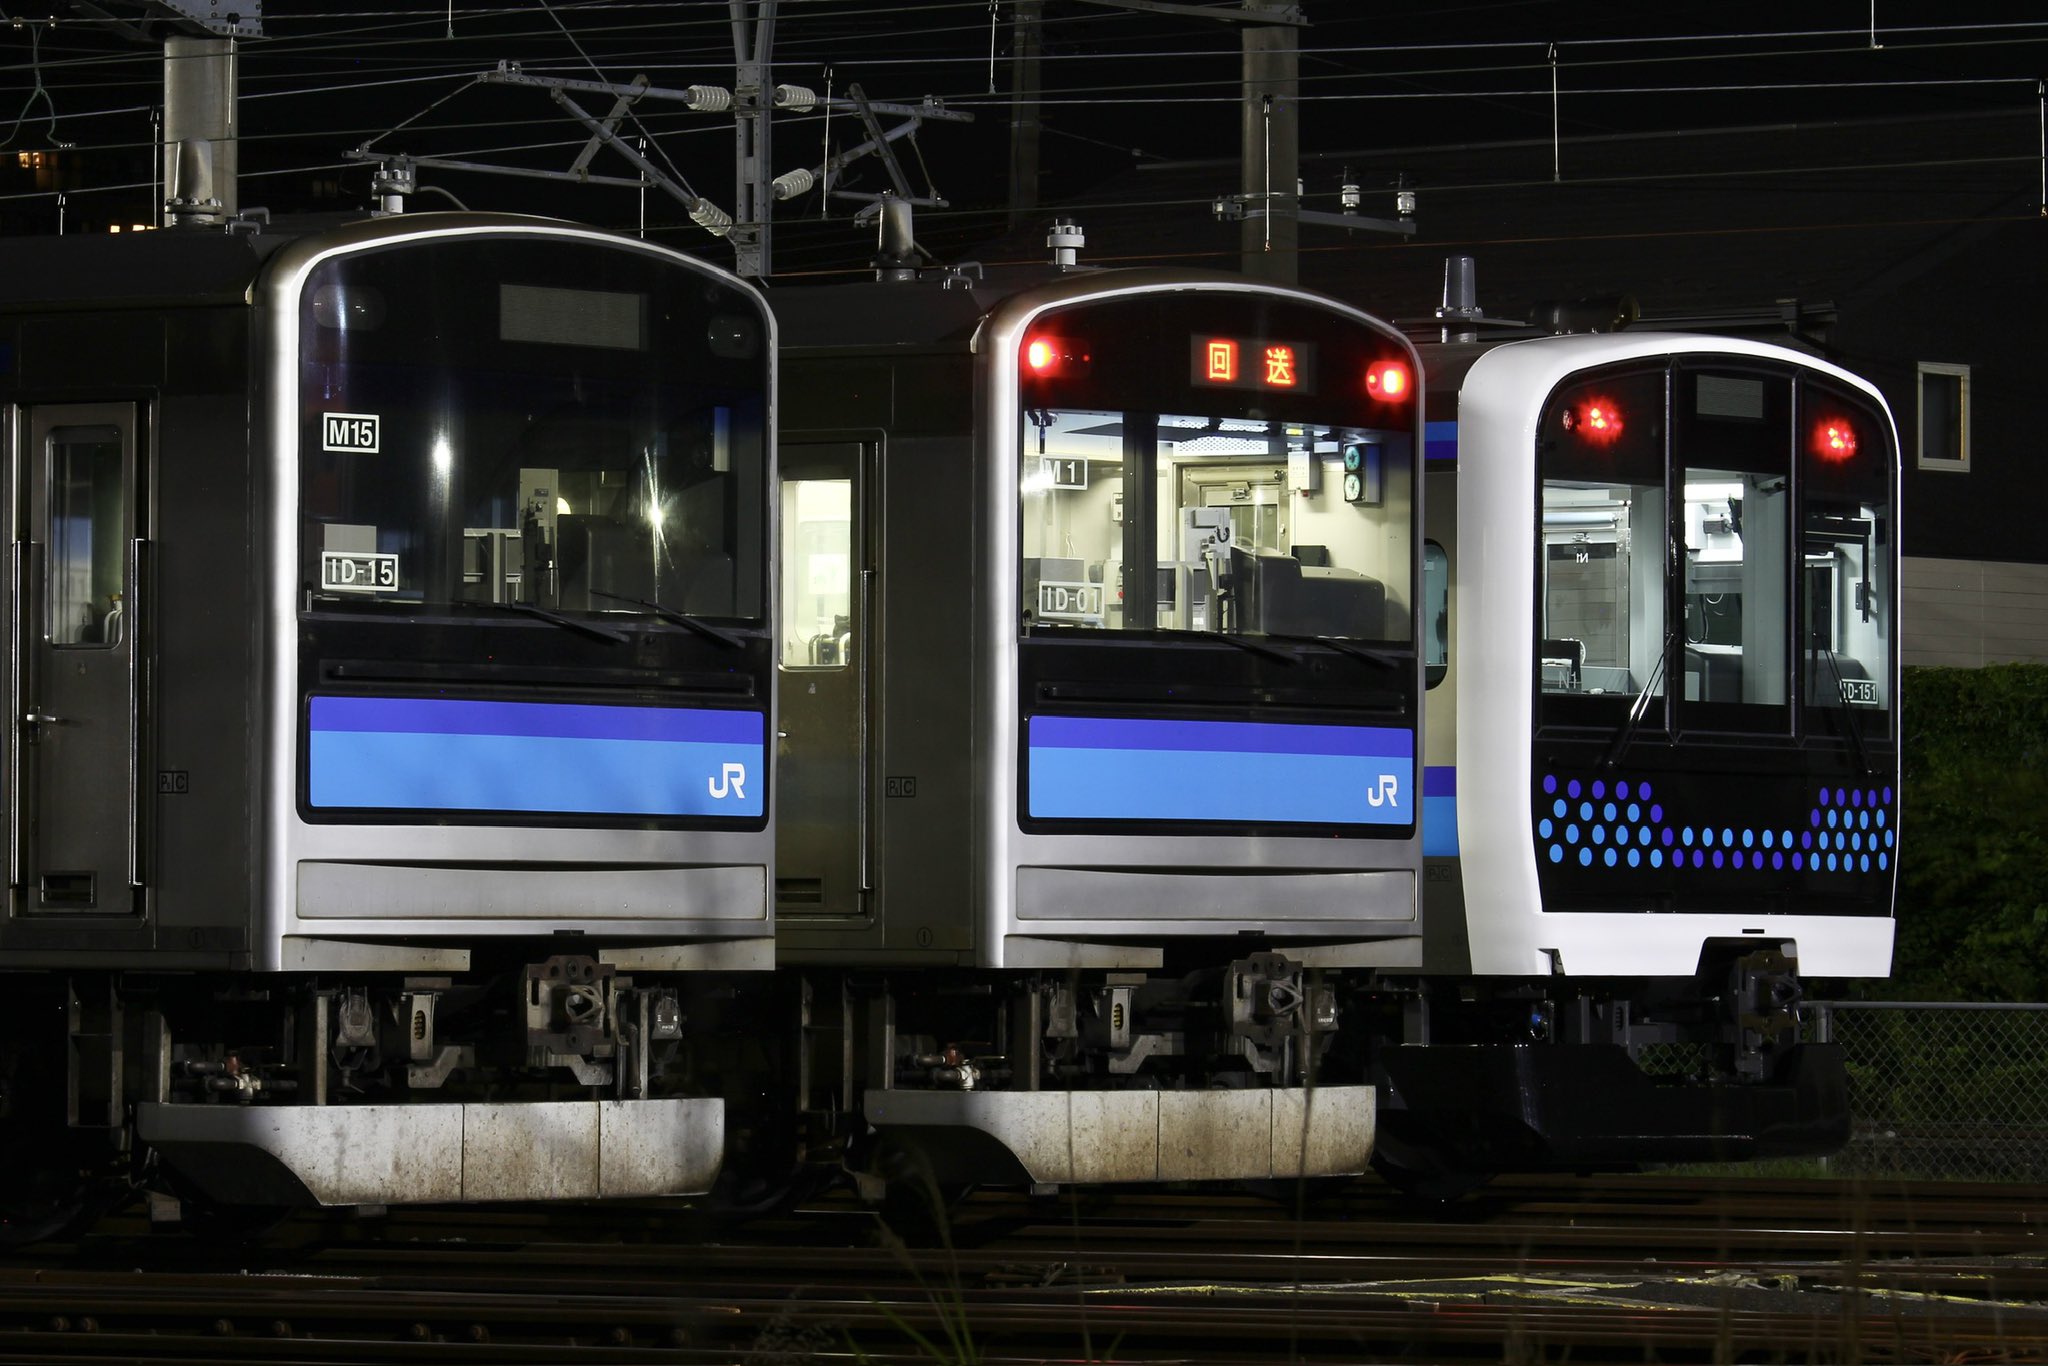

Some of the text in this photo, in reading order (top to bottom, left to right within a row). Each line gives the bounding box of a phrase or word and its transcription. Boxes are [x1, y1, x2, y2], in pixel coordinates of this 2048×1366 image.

[1208, 343, 1292, 385] 回送
[329, 419, 373, 447] M15
[331, 557, 394, 586] ID-15
[1047, 587, 1099, 614] ID-01
[1558, 670, 1578, 690] N1
[708, 762, 746, 799] JR
[1367, 774, 1398, 807] JR
